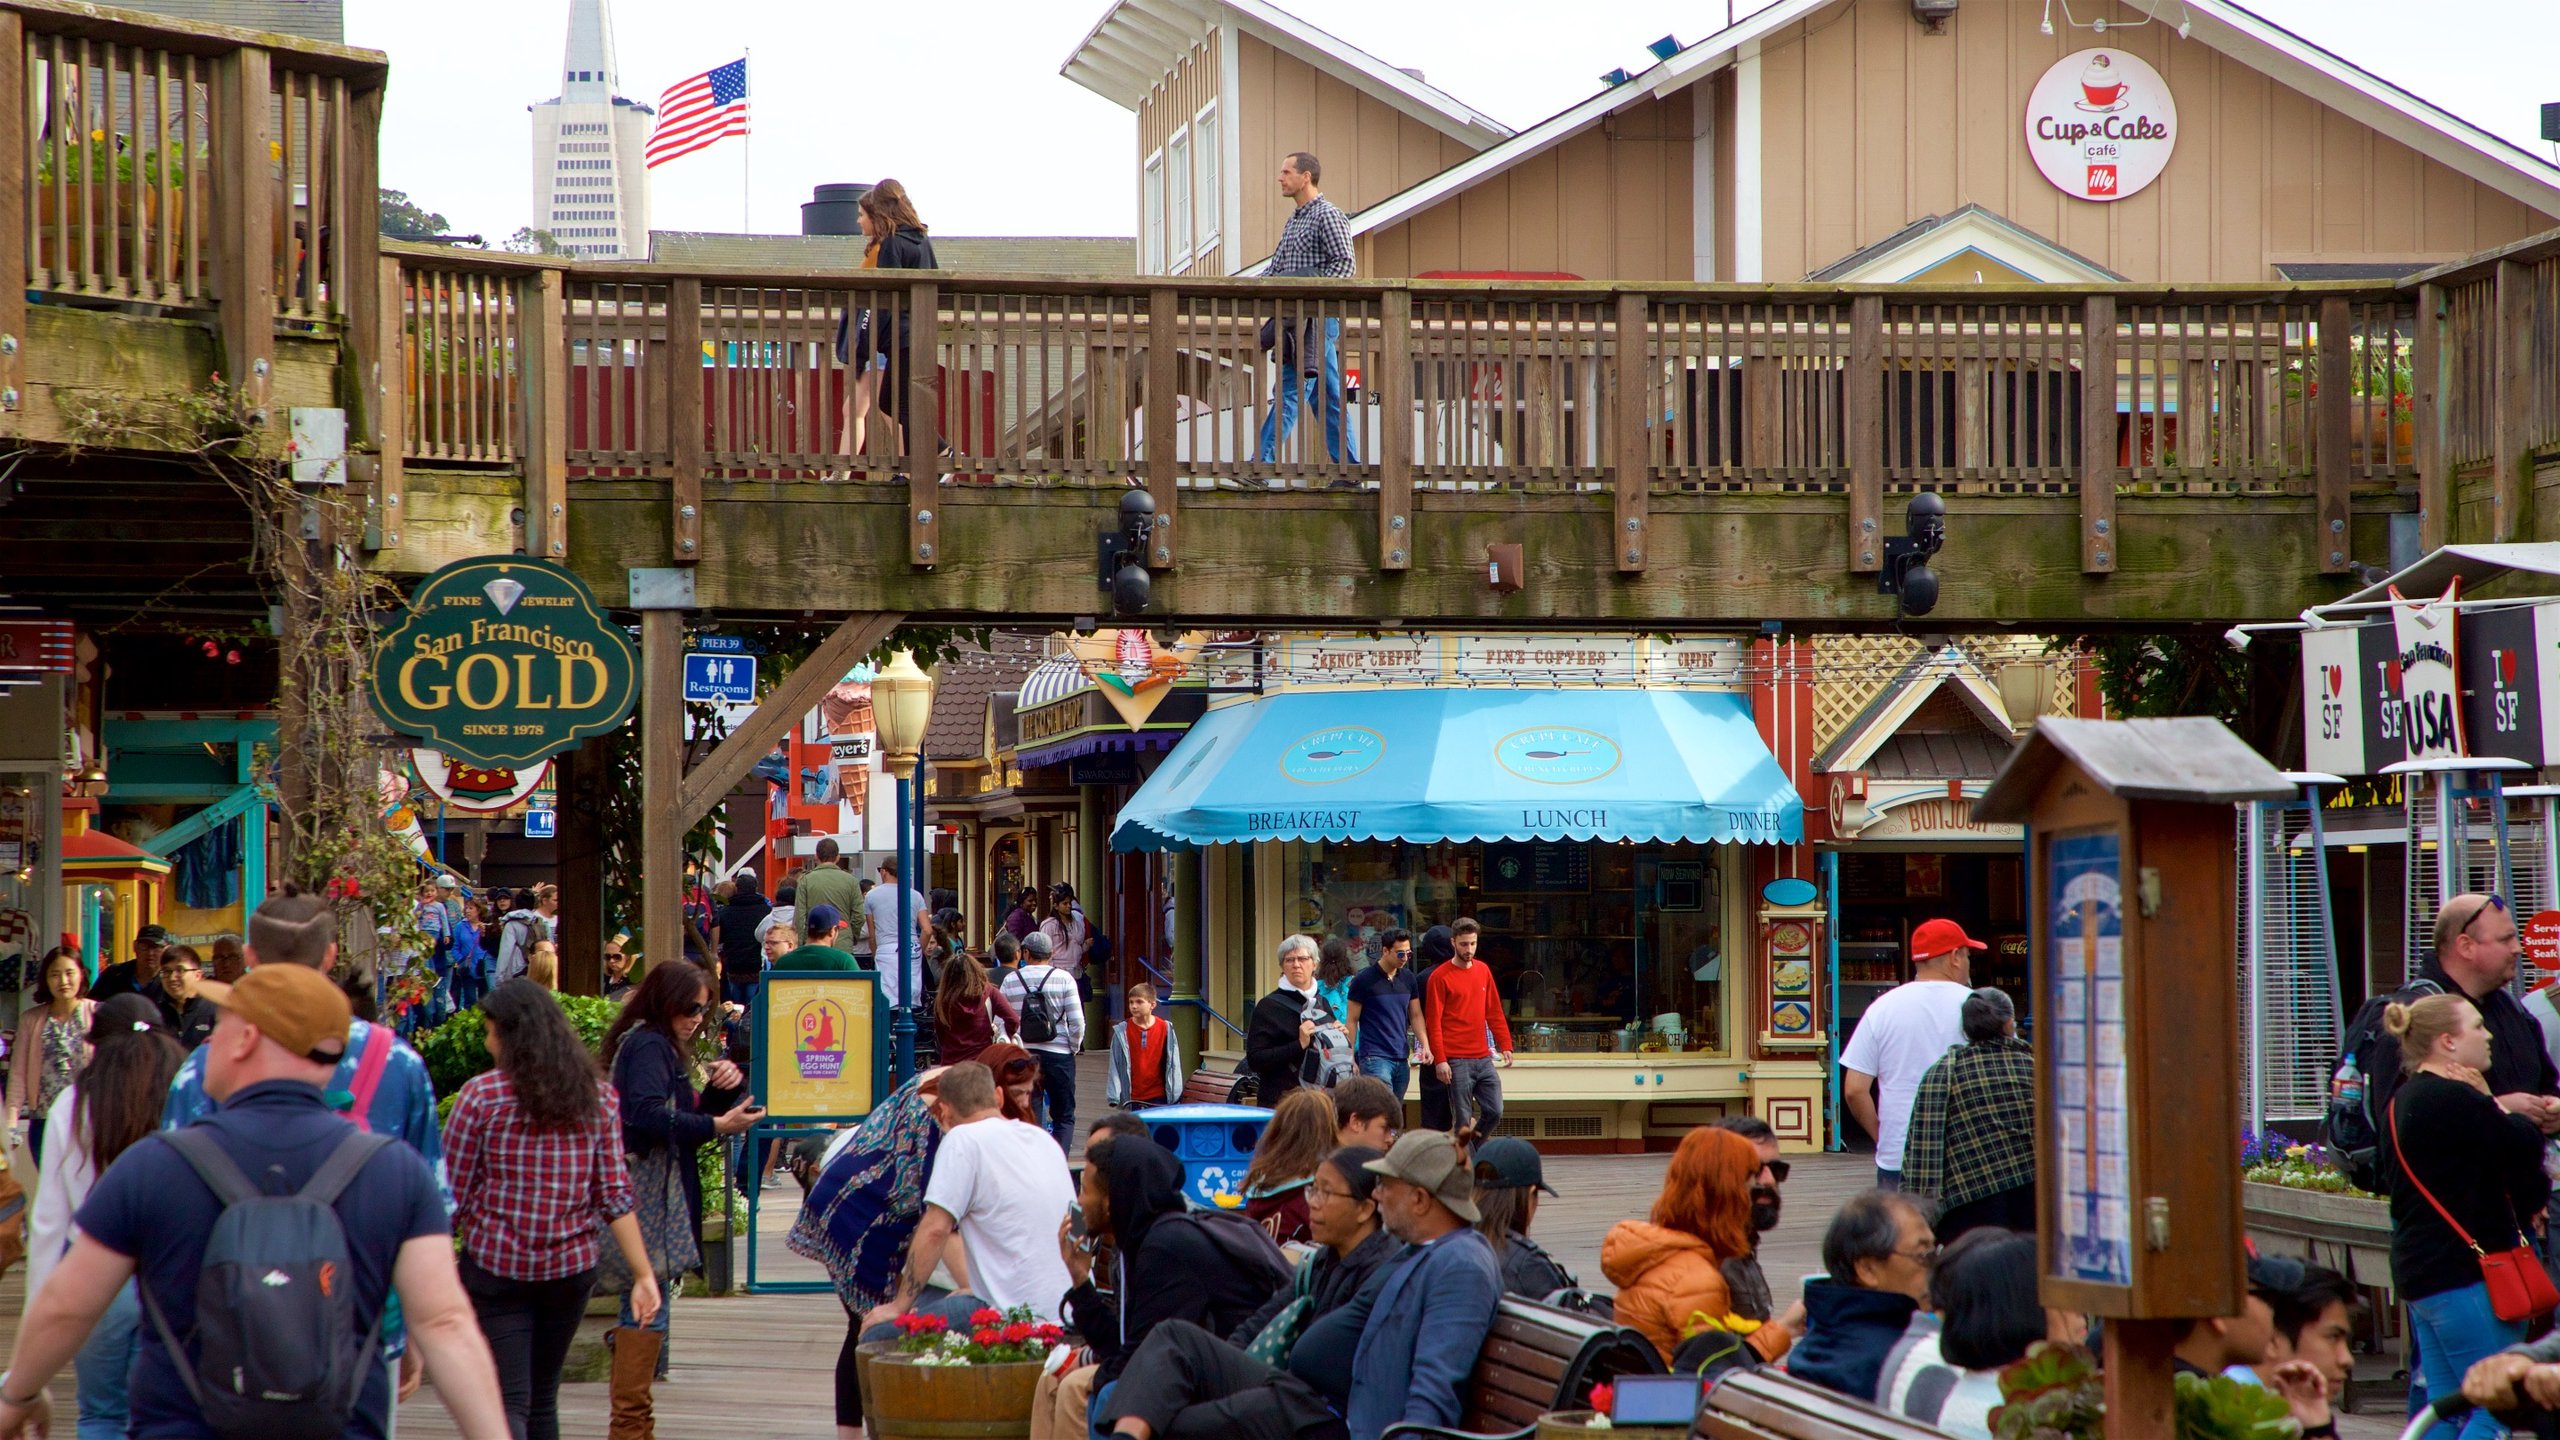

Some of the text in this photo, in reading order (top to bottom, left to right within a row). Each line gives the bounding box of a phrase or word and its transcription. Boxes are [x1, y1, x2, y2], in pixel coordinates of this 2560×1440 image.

[2087, 144, 2117, 156] café
[2089, 168, 2116, 192] illy
[442, 596, 575, 607] FINE JEWELRY
[413, 617, 595, 660] San Francisco
[702, 638, 740, 648] PIER 39
[1486, 649, 1606, 665] FINE COFFEES
[2491, 649, 2504, 689] I
[398, 652, 609, 711] GOLD
[689, 681, 749, 694] Restrooms
[2320, 665, 2329, 700] I
[2378, 660, 2389, 698] I
[2380, 700, 2402, 739] SF
[2494, 691, 2519, 732] SF
[463, 724, 545, 735] SINCE 1978
[2322, 703, 2343, 740] SF
[2403, 690, 2458, 756] USA
[832, 738, 868, 758] eyer's
[1248, 811, 1361, 831] BREAKFAST
[1522, 809, 1608, 828] LUNCH
[1728, 812, 1782, 831] DINNER
[2533, 924, 2560, 932] Servi
[2525, 937, 2559, 945] Sustain
[804, 1020, 814, 1030] 14
[800, 1062, 840, 1070] EGG HUNT
[805, 1054, 835, 1063] SPRING
